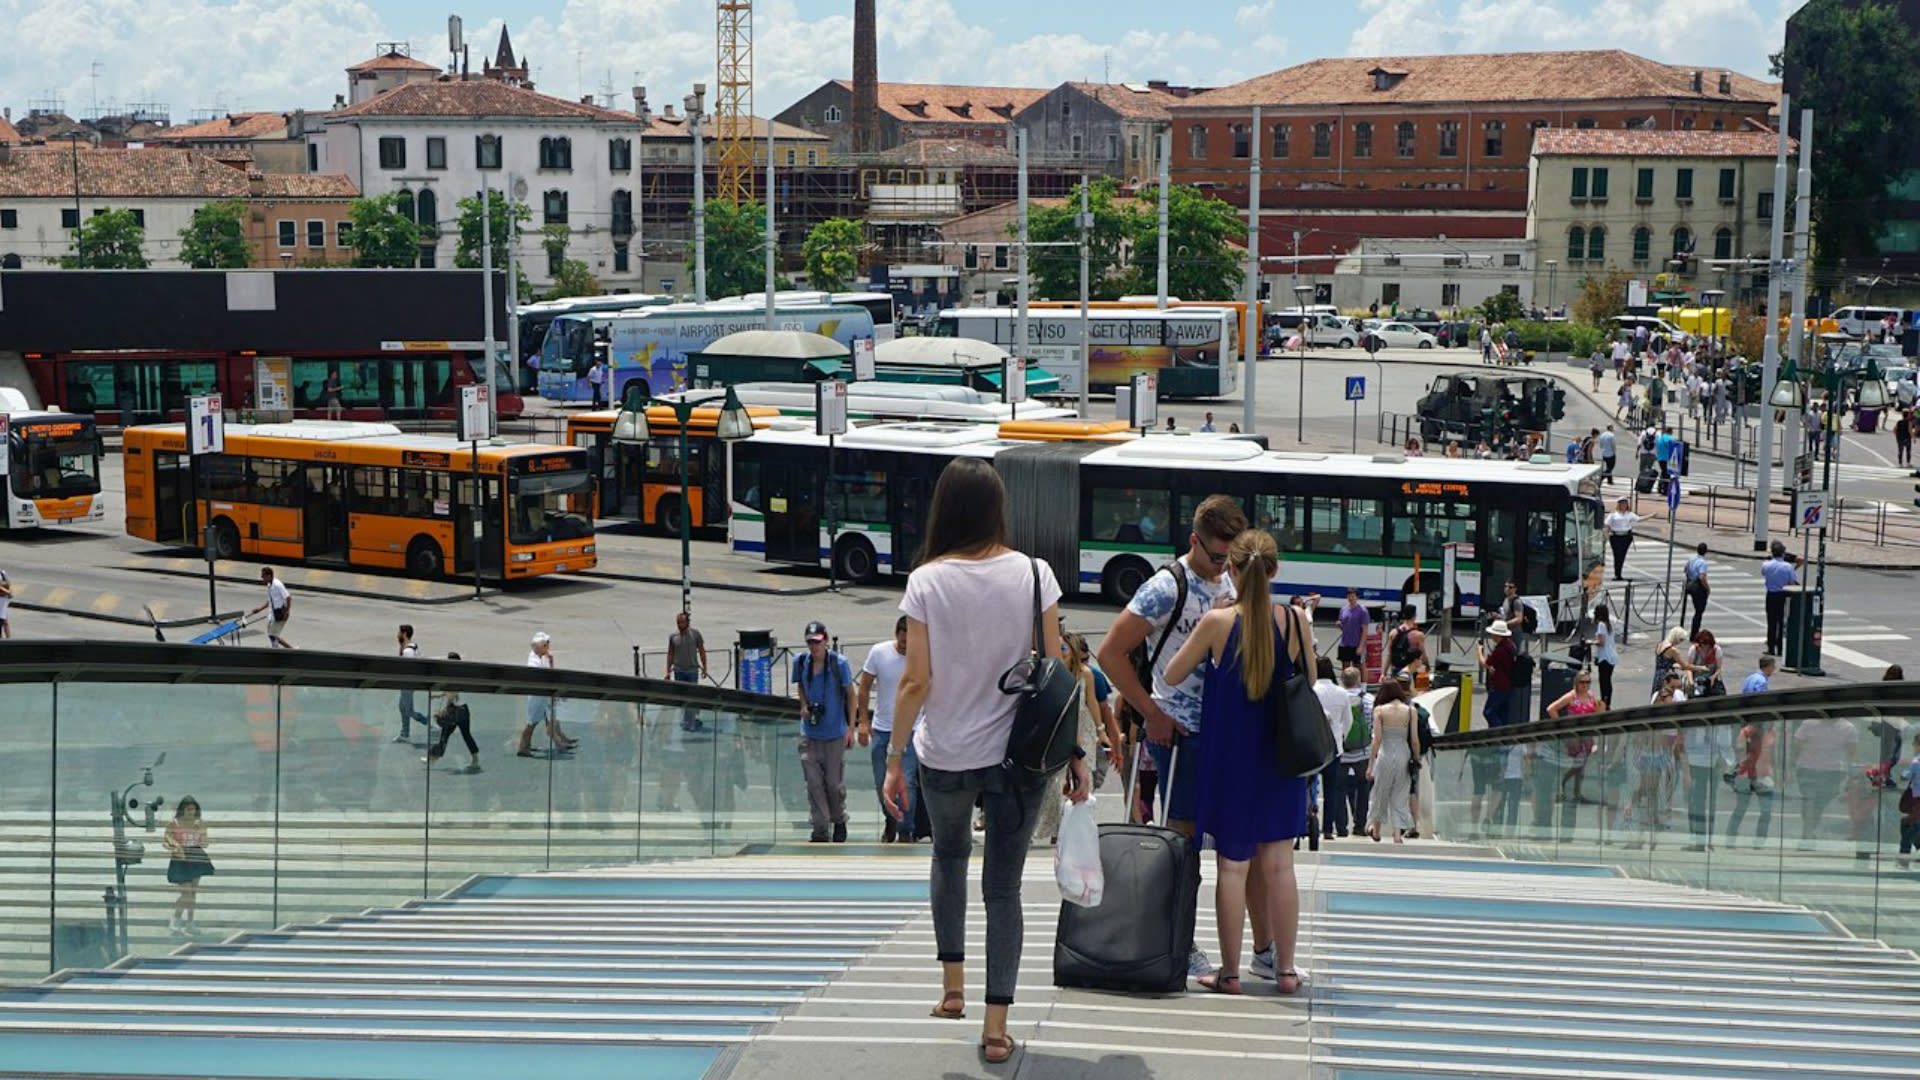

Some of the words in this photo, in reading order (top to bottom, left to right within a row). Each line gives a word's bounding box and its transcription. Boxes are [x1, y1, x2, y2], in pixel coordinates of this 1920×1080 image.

[680, 323, 725, 338] AIRPORT
[1009, 323, 1066, 339] TEVISO
[1093, 324, 1116, 338] GET
[1120, 324, 1172, 338] CARRIED
[1176, 325, 1212, 339] AWAY
[201, 414, 214, 447] 1
[313, 449, 337, 460] uscita
